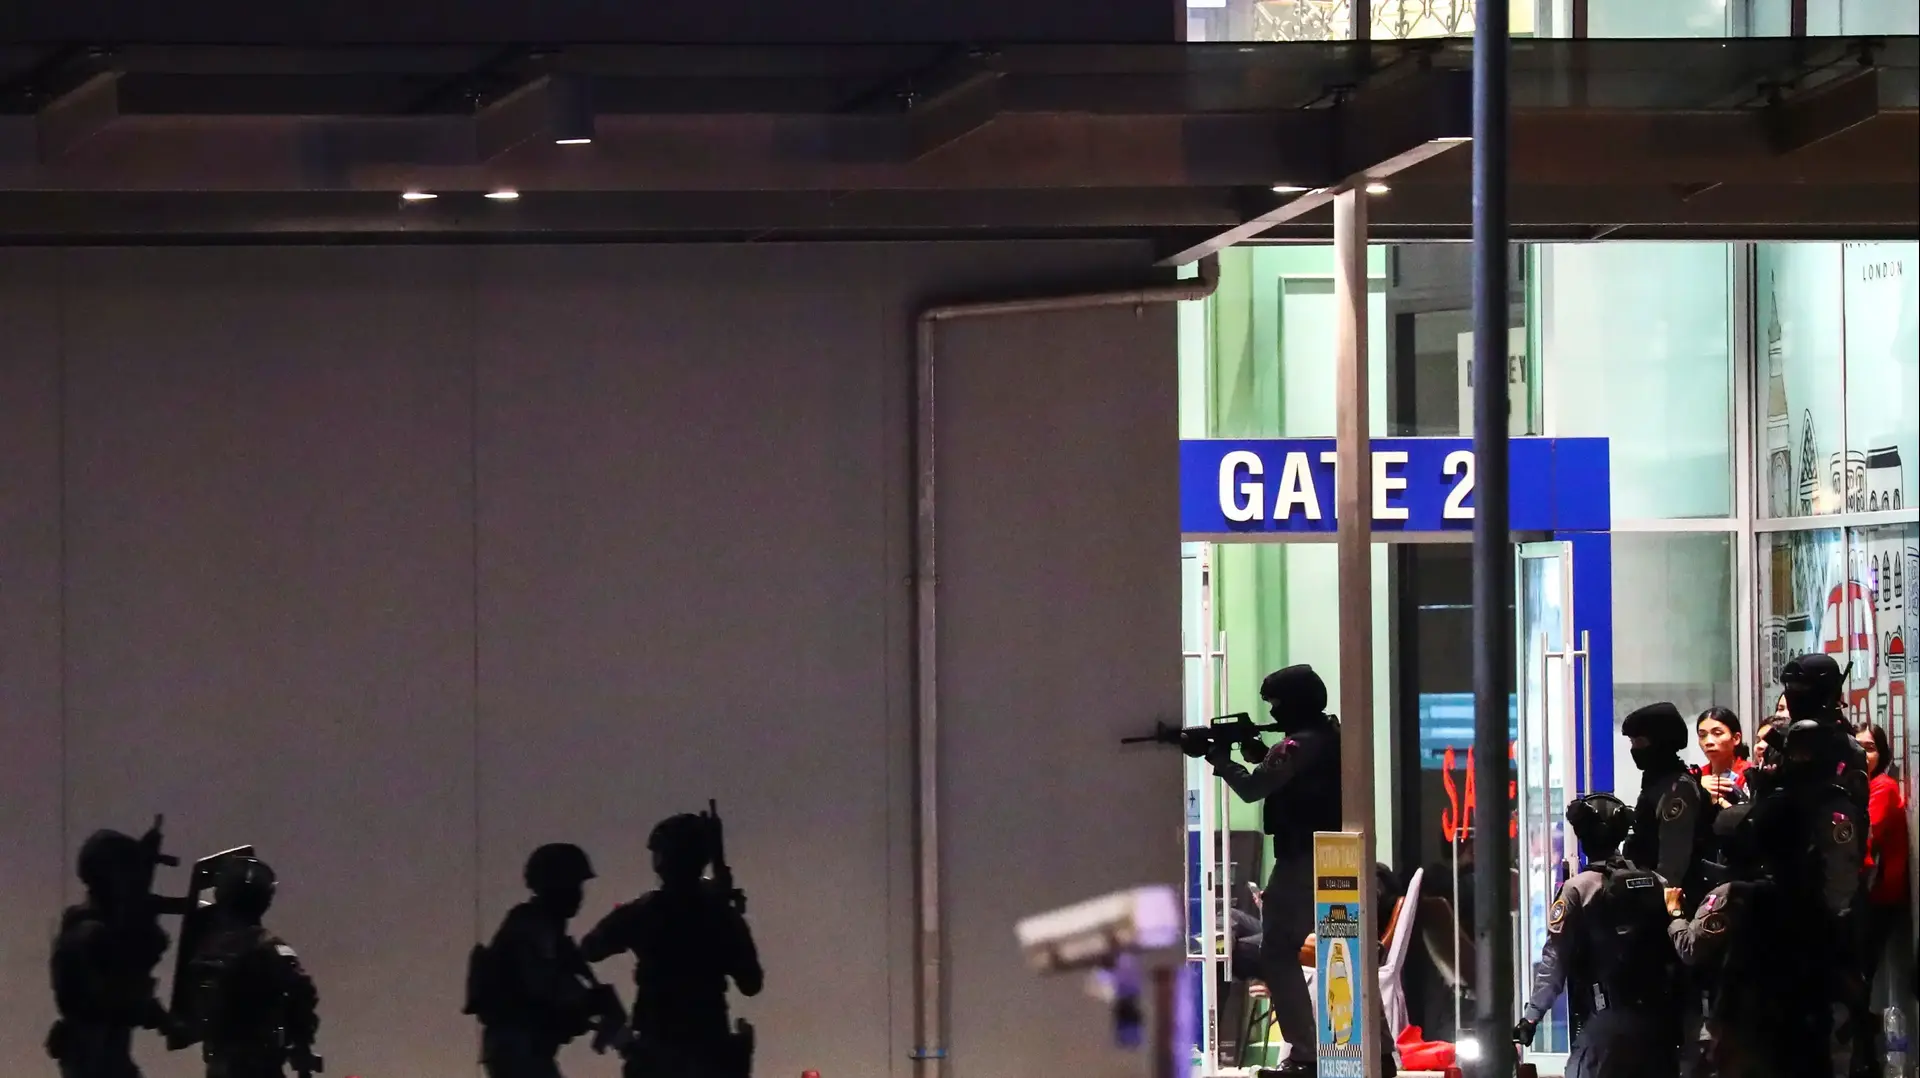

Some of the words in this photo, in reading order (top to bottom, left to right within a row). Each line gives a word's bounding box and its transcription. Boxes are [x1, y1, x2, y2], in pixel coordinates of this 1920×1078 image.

[1862, 260, 1903, 281] LONDON
[1218, 450, 1409, 522] GAE
[1442, 450, 1476, 520] 2
[1320, 1059, 1335, 1077] TAXI
[1335, 1059, 1362, 1078] SERVICE
